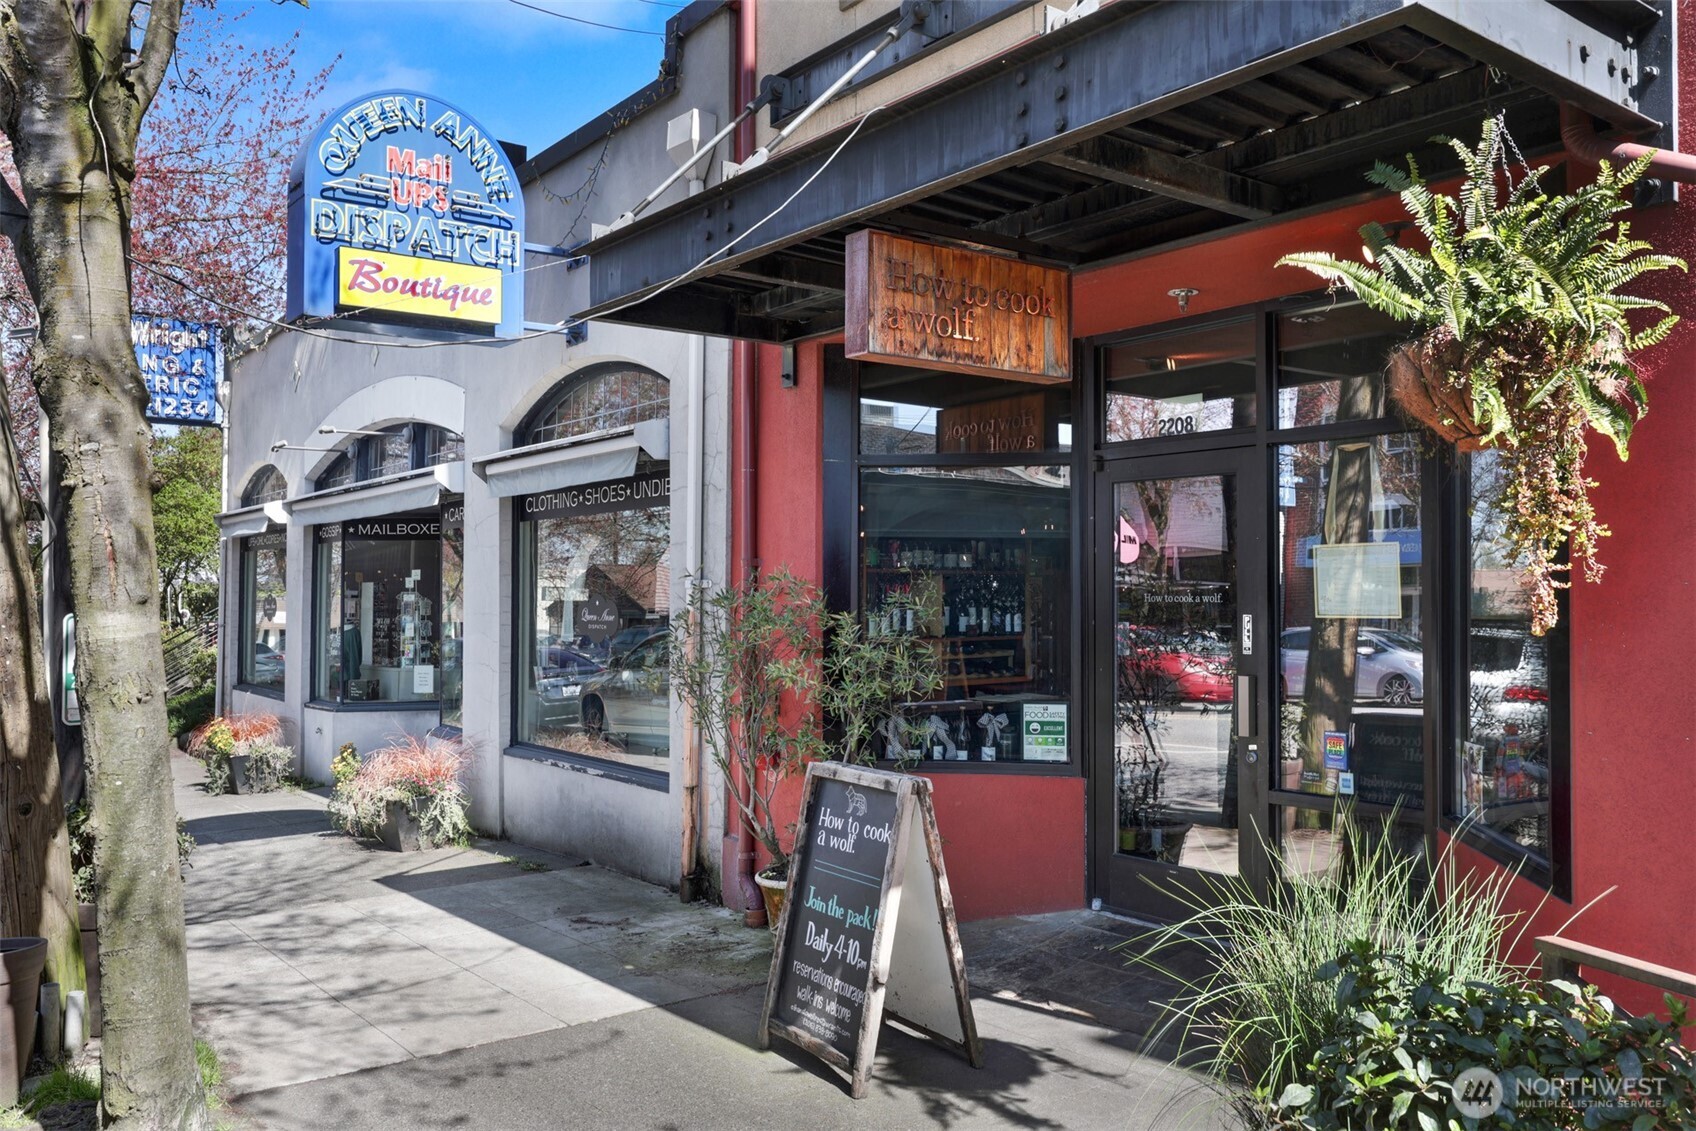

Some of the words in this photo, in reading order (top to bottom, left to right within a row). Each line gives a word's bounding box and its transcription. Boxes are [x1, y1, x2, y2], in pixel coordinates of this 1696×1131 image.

[319, 96, 427, 172] QUEEN
[431, 110, 514, 202] ANNE
[387, 145, 452, 184] Mail
[390, 177, 450, 212] UPS
[311, 198, 520, 267] DISPATCH
[347, 258, 493, 312] Boutique
[887, 257, 955, 301] How
[961, 278, 990, 307] to
[995, 286, 1056, 318] cook
[131, 321, 208, 354] Wright
[888, 306, 904, 330] a
[910, 306, 980, 342] wolf.
[191, 359, 207, 378] &
[1158, 415, 1194, 436] 2208
[525, 491, 579, 513] CLOTHING
[584, 484, 626, 506] SHOES
[321, 525, 340, 539] GOSSIP
[358, 523, 440, 535] MAILBOXE
[581, 607, 597, 622] Queen
[598, 608, 615, 621] Anne
[1143, 593, 1164, 603] How
[1164, 593, 1173, 603] to
[1174, 593, 1194, 603] cook
[1195, 595, 1201, 603] a
[1025, 711, 1050, 719] FOOD
[1328, 740, 1343, 750] SAFE
[817, 830, 826, 846] a
[830, 833, 857, 854] wolf.
[818, 807, 844, 831] How
[847, 816, 860, 836] to
[863, 823, 892, 844] cook
[804, 885, 826, 914] Join
[827, 894, 845, 919] the
[805, 921, 834, 963] Daily
[793, 960, 833, 990] reservations
[796, 984, 824, 1009] walk-ins
[825, 997, 852, 1023] welcome
